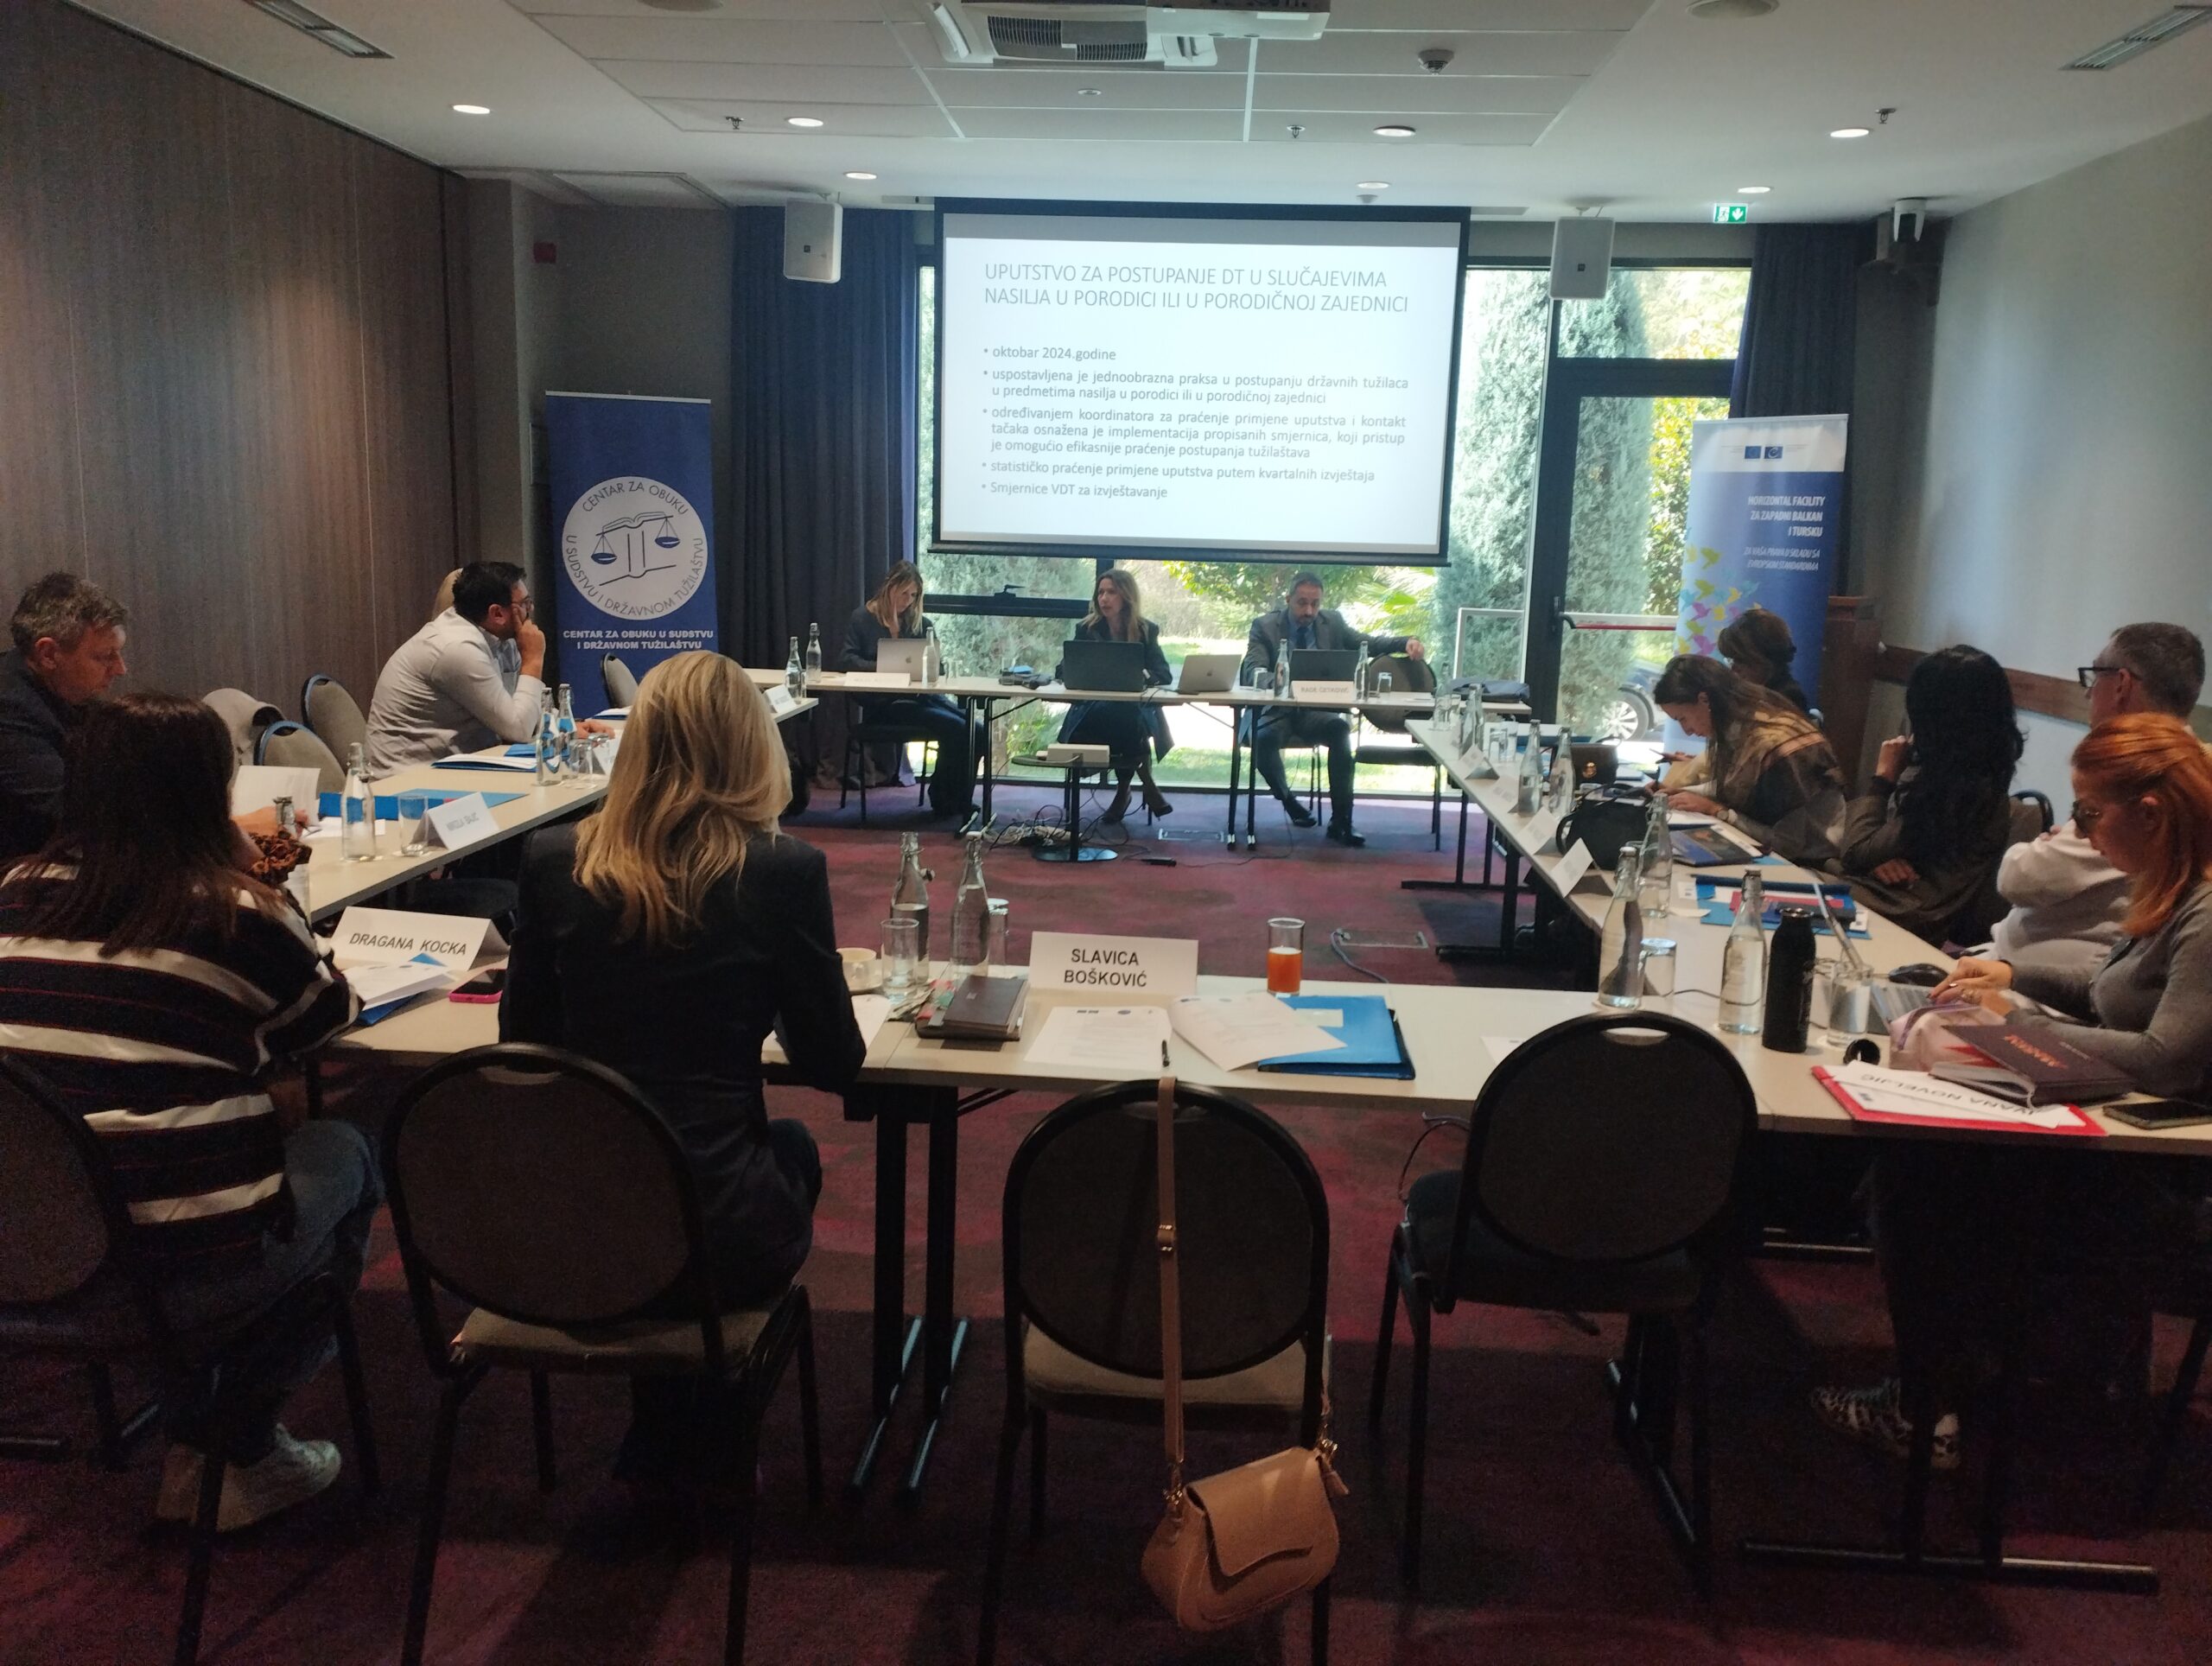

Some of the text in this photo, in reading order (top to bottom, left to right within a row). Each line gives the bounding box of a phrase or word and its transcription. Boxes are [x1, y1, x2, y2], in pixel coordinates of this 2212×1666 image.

[985, 264, 1387, 287] UPUTSTVO ZA POSTUPANJE DT U SLUČAJEVIMA
[985, 288, 1408, 312] NASILJA U PORODICI ILI U PORODIČNOJ ZAJEDNICI
[992, 346, 1116, 361] oktobar 2024.godine
[992, 369, 1408, 389] uspostavljena je jednoobrazna praksa u postupanju državnih tužilaca
[992, 385, 1326, 404] u predmetima nasilja u porodici ili u porodičnoj zajednici
[992, 406, 1407, 429] određivanjem koordinatora za praćenje primjene uputstva i kontakt
[992, 422, 1405, 446] tačaka osnažena je implementacija propisanih smjernica, koji pristup
[990, 439, 1310, 460] je omogućio efikasnije praćenje postupanja tužilaštava
[990, 461, 1375, 483] statističko praćenje primjene uputstva putem kvartalnih izvještaja
[582, 481, 690, 515] CENTAR ZA OBUKU
[990, 482, 1167, 499] Smjernice VDT za izvještavanje
[1747, 496, 1825, 506] HORIZONTAL FACILITY
[1750, 510, 1823, 522] ZA ZAPADNI BALKAN
[1792, 526, 1823, 537] TURSKU
[566, 535, 703, 616] U SUDSTVU I DRŽAVNOM TUŽILAŠTVU
[584, 639, 639, 649] DRŽAVNOM
[641, 639, 702, 649] TUŽILAŠTVU
[349, 933, 468, 956] DRAGANA KOCKA
[1071, 948, 1139, 966] SLAVICA
[1065, 968, 1147, 987] BOŠKOVIĆ
